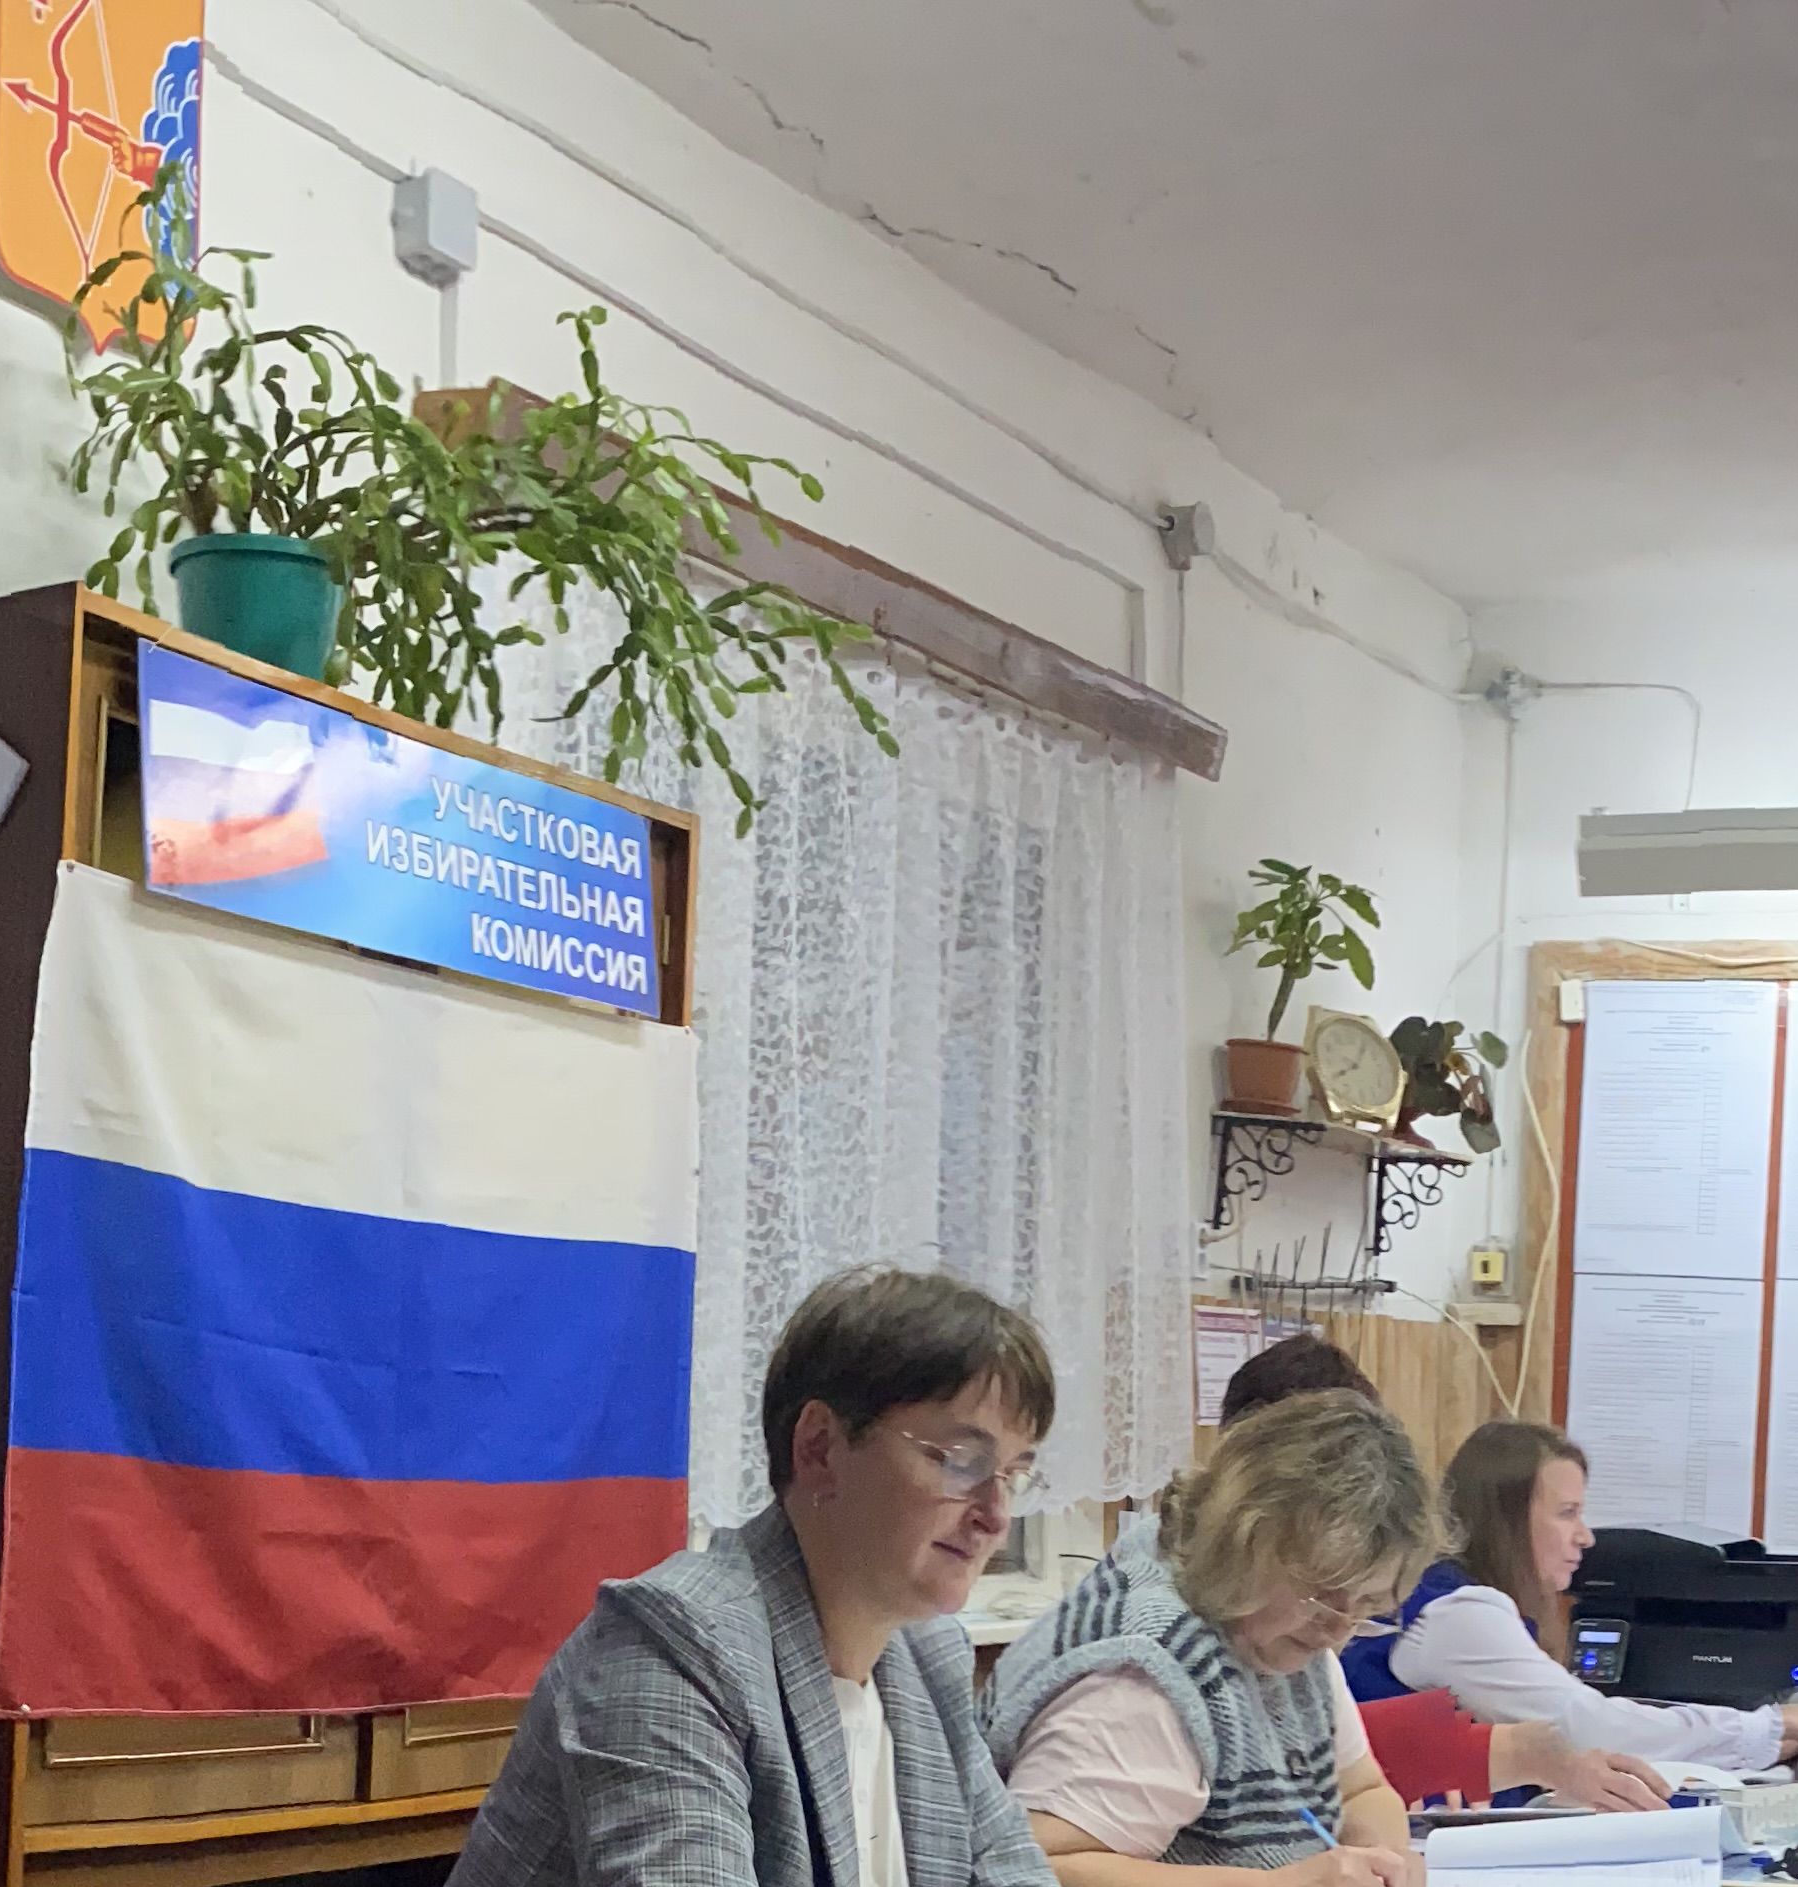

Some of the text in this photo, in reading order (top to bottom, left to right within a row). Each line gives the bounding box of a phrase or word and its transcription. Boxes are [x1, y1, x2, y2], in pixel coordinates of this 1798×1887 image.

[365, 819, 646, 938] ИЗБИРАТЕЛЬНАЯ
[429, 777, 643, 880] УЧАСТКОВАЯ
[470, 912, 649, 995] КОМИССИЯ
